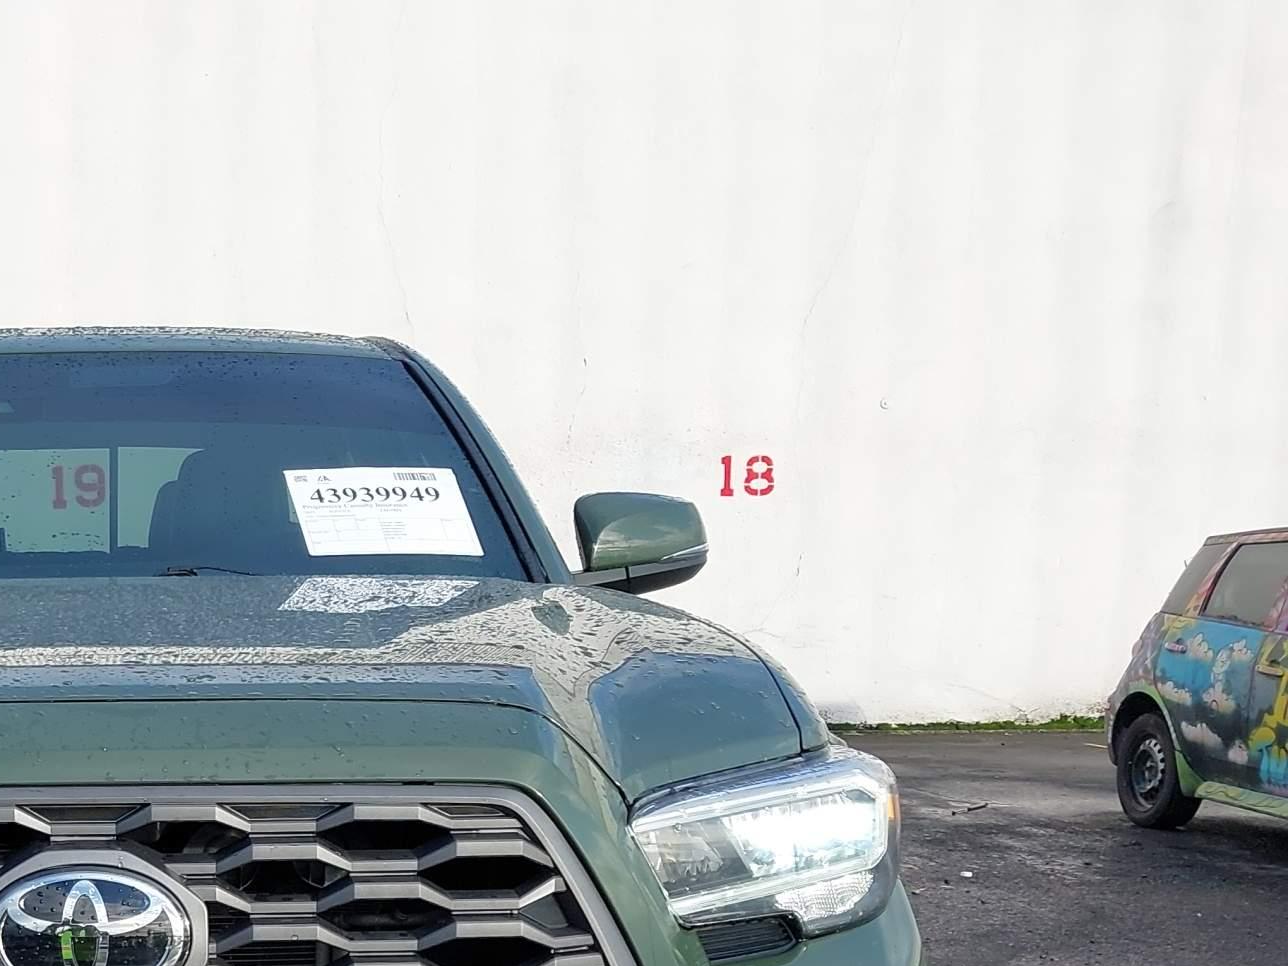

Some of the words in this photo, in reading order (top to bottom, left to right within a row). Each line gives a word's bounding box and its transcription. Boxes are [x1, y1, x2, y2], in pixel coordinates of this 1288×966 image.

[51, 464, 106, 509] 19
[309, 486, 440, 503] 43939949
[719, 455, 775, 497] 18
